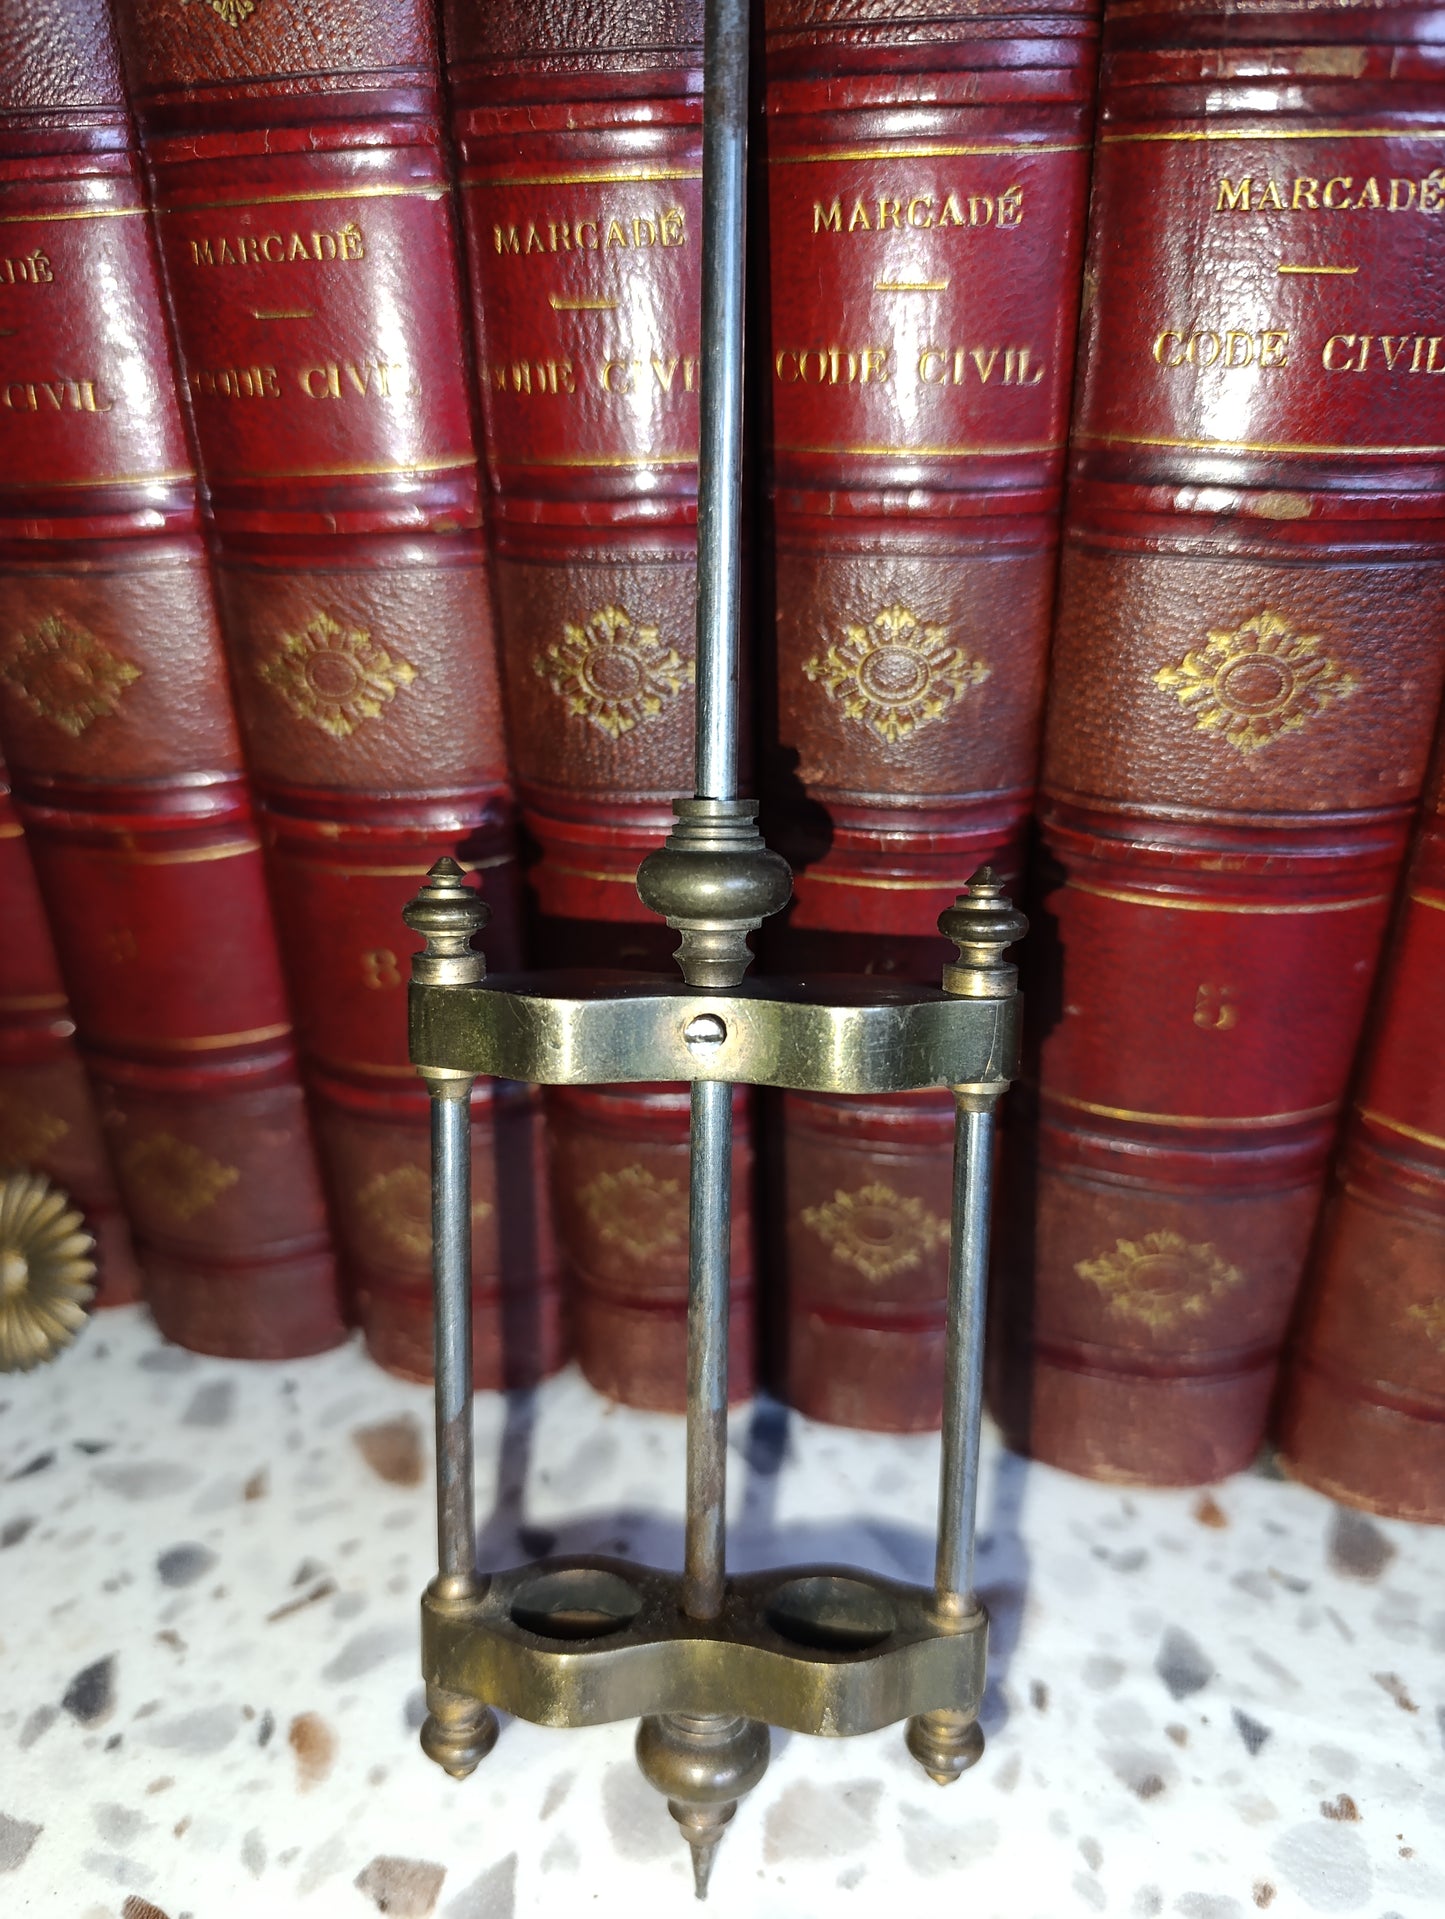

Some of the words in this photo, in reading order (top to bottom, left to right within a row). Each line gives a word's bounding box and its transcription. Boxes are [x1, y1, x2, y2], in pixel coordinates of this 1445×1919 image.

[811, 185, 1025, 234] MARCADÉ
[1215, 168, 1445, 213] MARCADÉ
[191, 224, 365, 266] MARCADÉ
[494, 207, 685, 255] MARCADÉ
[0, 249, 54, 284] DÉ
[775, 346, 889, 386] CODE
[918, 346, 1045, 387] CIVIL
[1152, 329, 1290, 368] CODE
[1321, 333, 1445, 374] CIVIL
[4, 379, 113, 413] CIVIL
